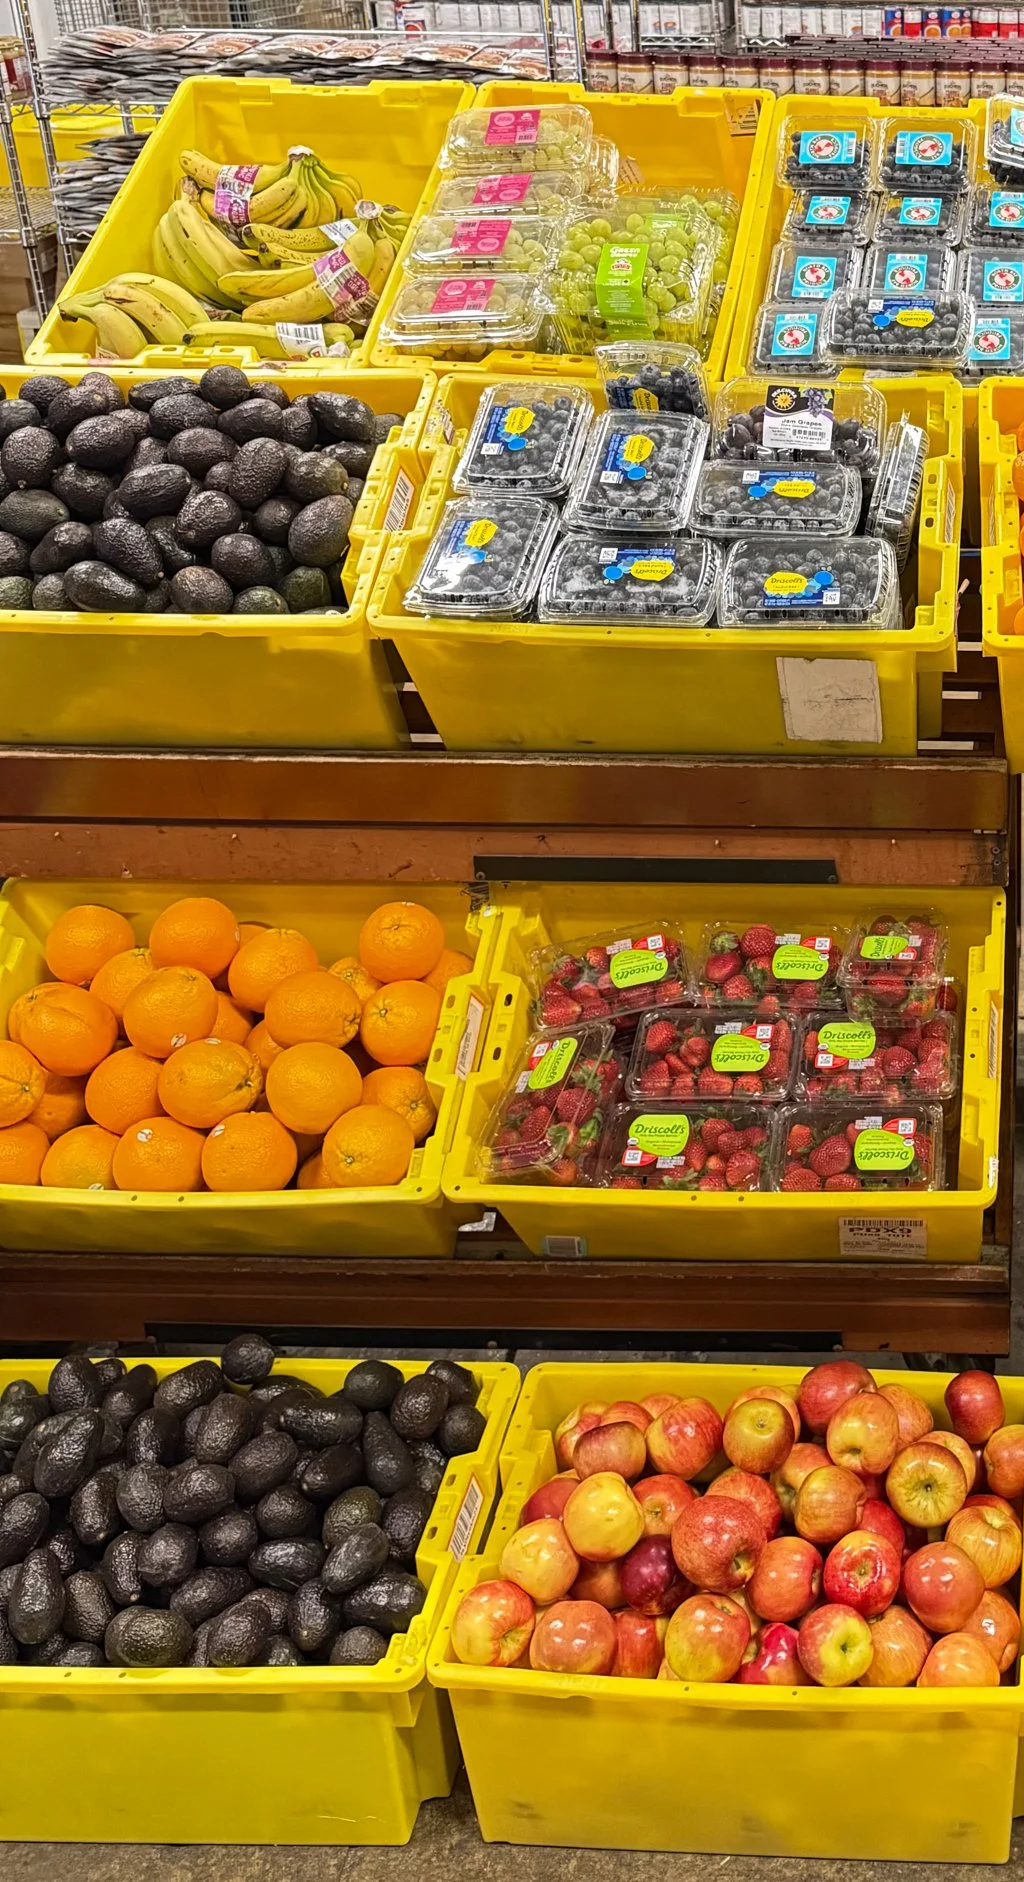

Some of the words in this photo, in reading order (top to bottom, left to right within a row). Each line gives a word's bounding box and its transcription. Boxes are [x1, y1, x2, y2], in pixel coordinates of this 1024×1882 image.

[615, 962, 665, 979] Driscoll's
[775, 961, 824, 973] Driscoll's
[823, 1030, 872, 1040] Driscoll's
[546, 1041, 571, 1083] Driscoll's
[715, 1052, 765, 1064] Driscoll's
[634, 1123, 686, 1135] Driscoll's
[857, 1150, 910, 1161] Driscoll's
[849, 1226, 913, 1234] PDX9
